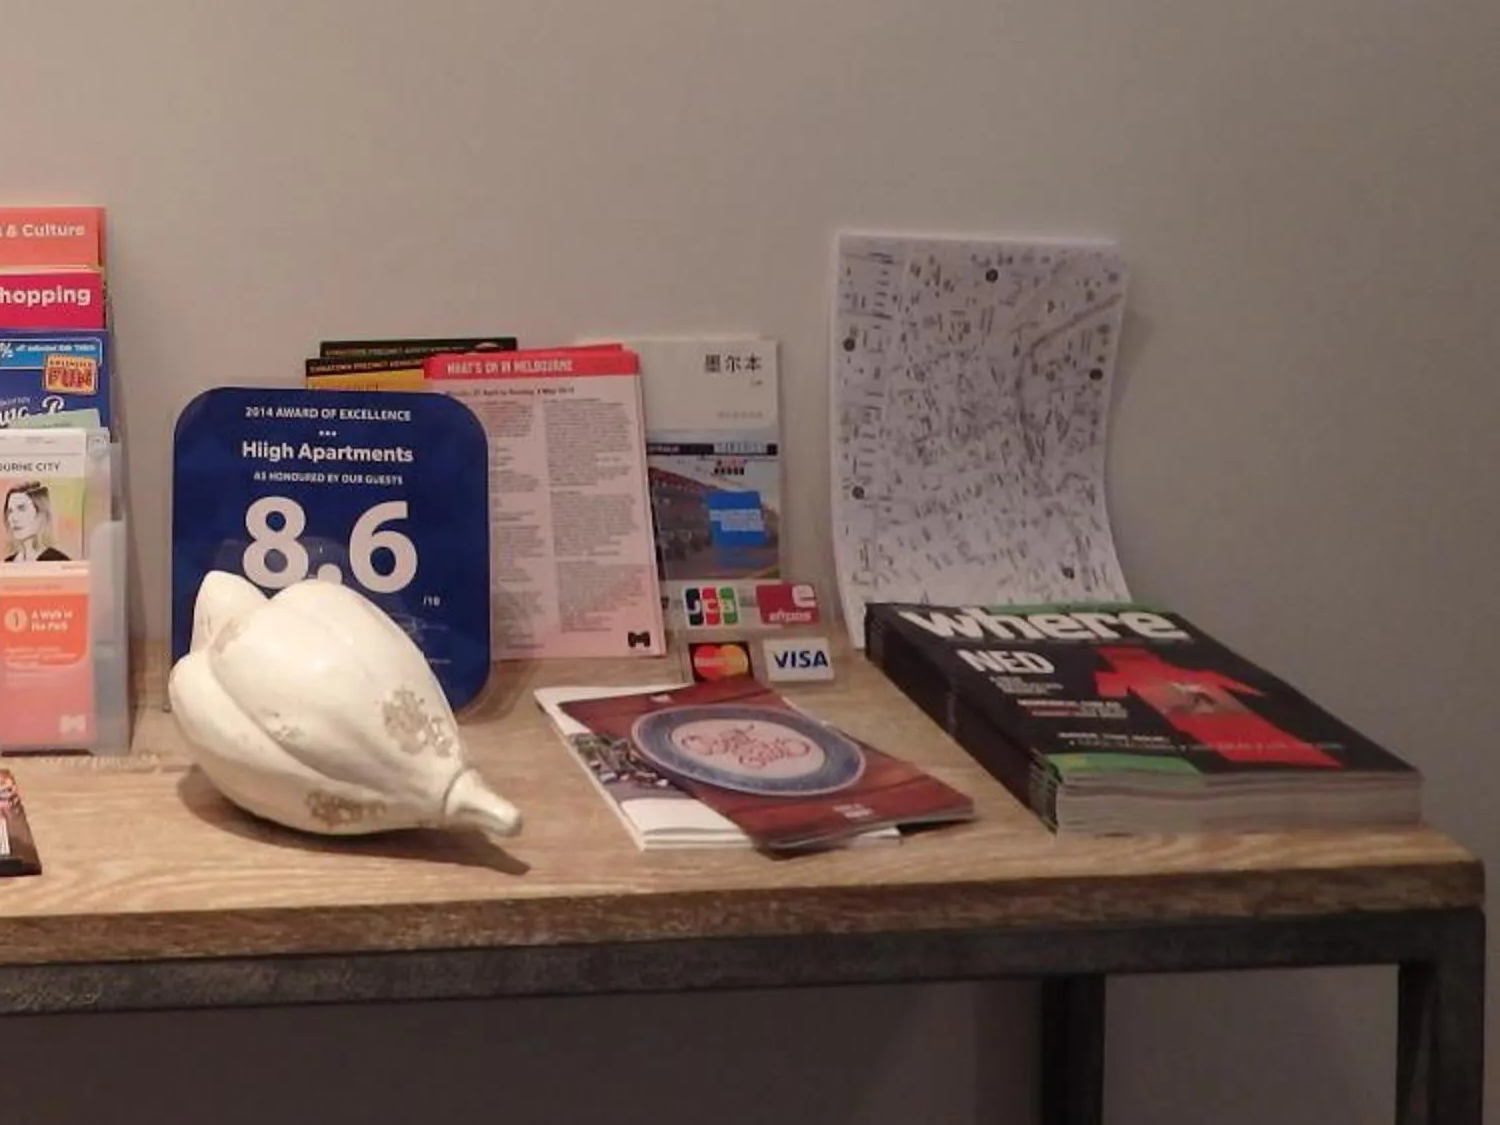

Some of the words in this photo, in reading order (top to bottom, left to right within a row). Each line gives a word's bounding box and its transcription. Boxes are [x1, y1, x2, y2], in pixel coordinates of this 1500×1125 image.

[6, 224, 18, 238] &
[22, 223, 85, 238] Culture
[245, 407, 273, 418] 2014
[275, 407, 318, 418] AWARD
[321, 408, 337, 419] OF
[339, 409, 411, 421] EXCELLENCE
[297, 442, 414, 463] Apartments
[35, 460, 61, 472] CITY
[341, 473, 363, 484] OUR
[365, 474, 403, 485] GUESTS
[899, 606, 1193, 640] where
[774, 650, 829, 669] VISA
[956, 649, 1056, 674] NED
